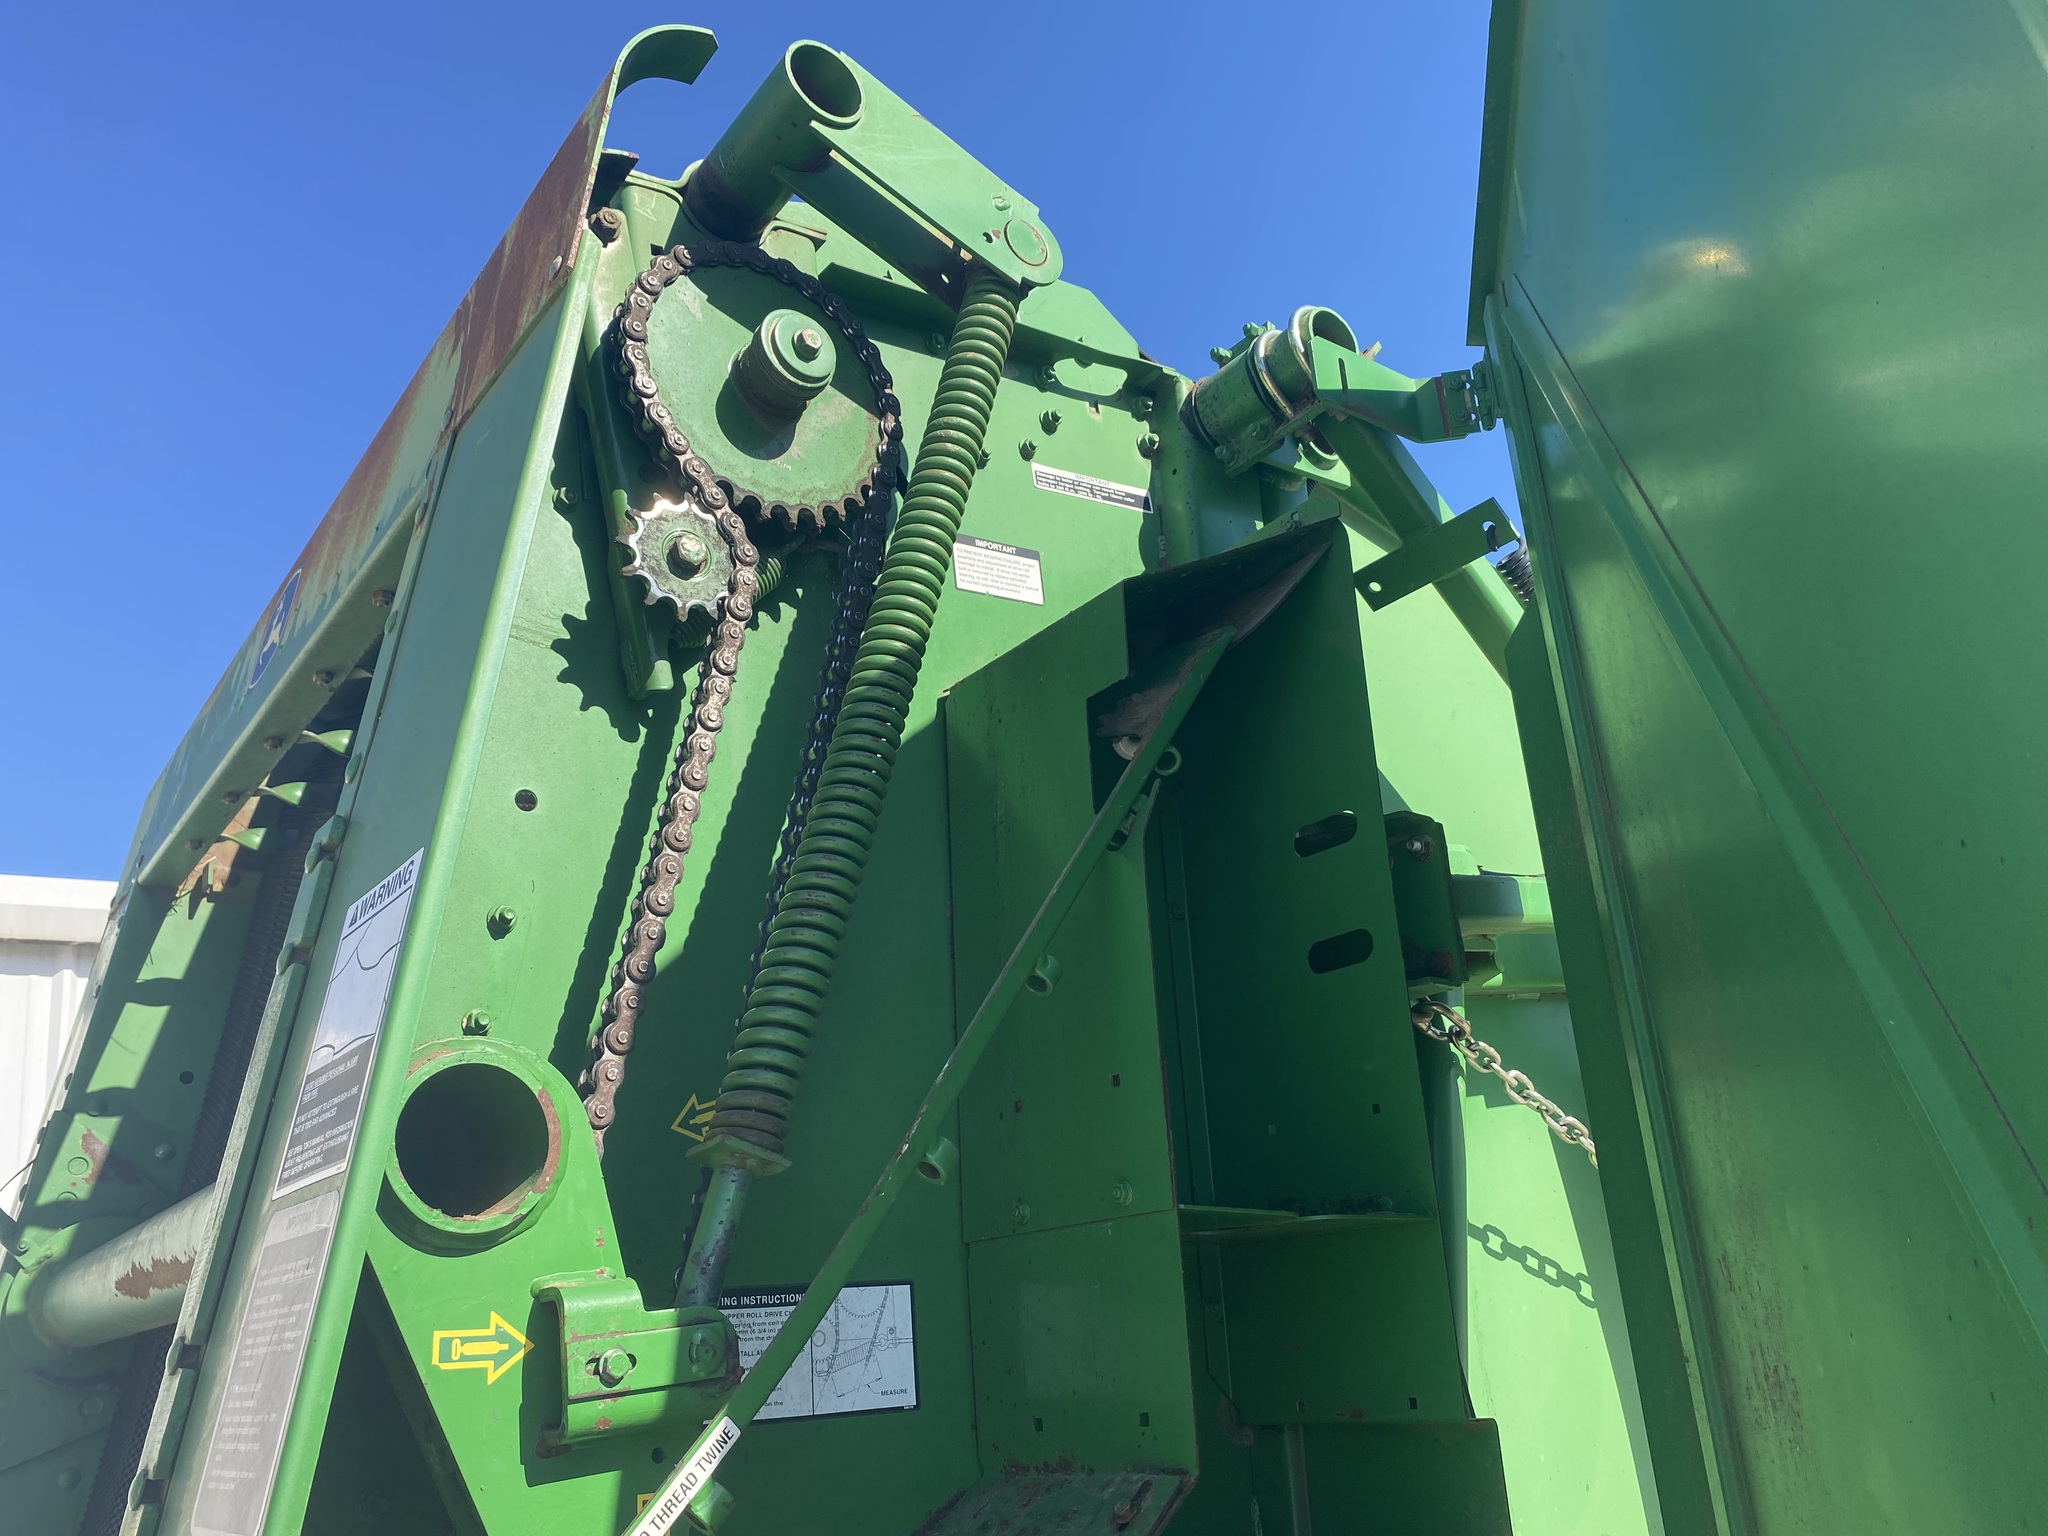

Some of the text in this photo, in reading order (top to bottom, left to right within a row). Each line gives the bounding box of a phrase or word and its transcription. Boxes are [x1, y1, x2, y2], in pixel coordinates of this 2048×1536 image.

[1037, 472, 1055, 480] Damage
[1075, 474, 1109, 487] IMPORTANT
[975, 539, 1016, 554] IMPORTANT
[358, 860, 414, 920] WARNING
[721, 1296, 737, 1306] ING
[649, 1426, 734, 1530] THREAD TWINE
